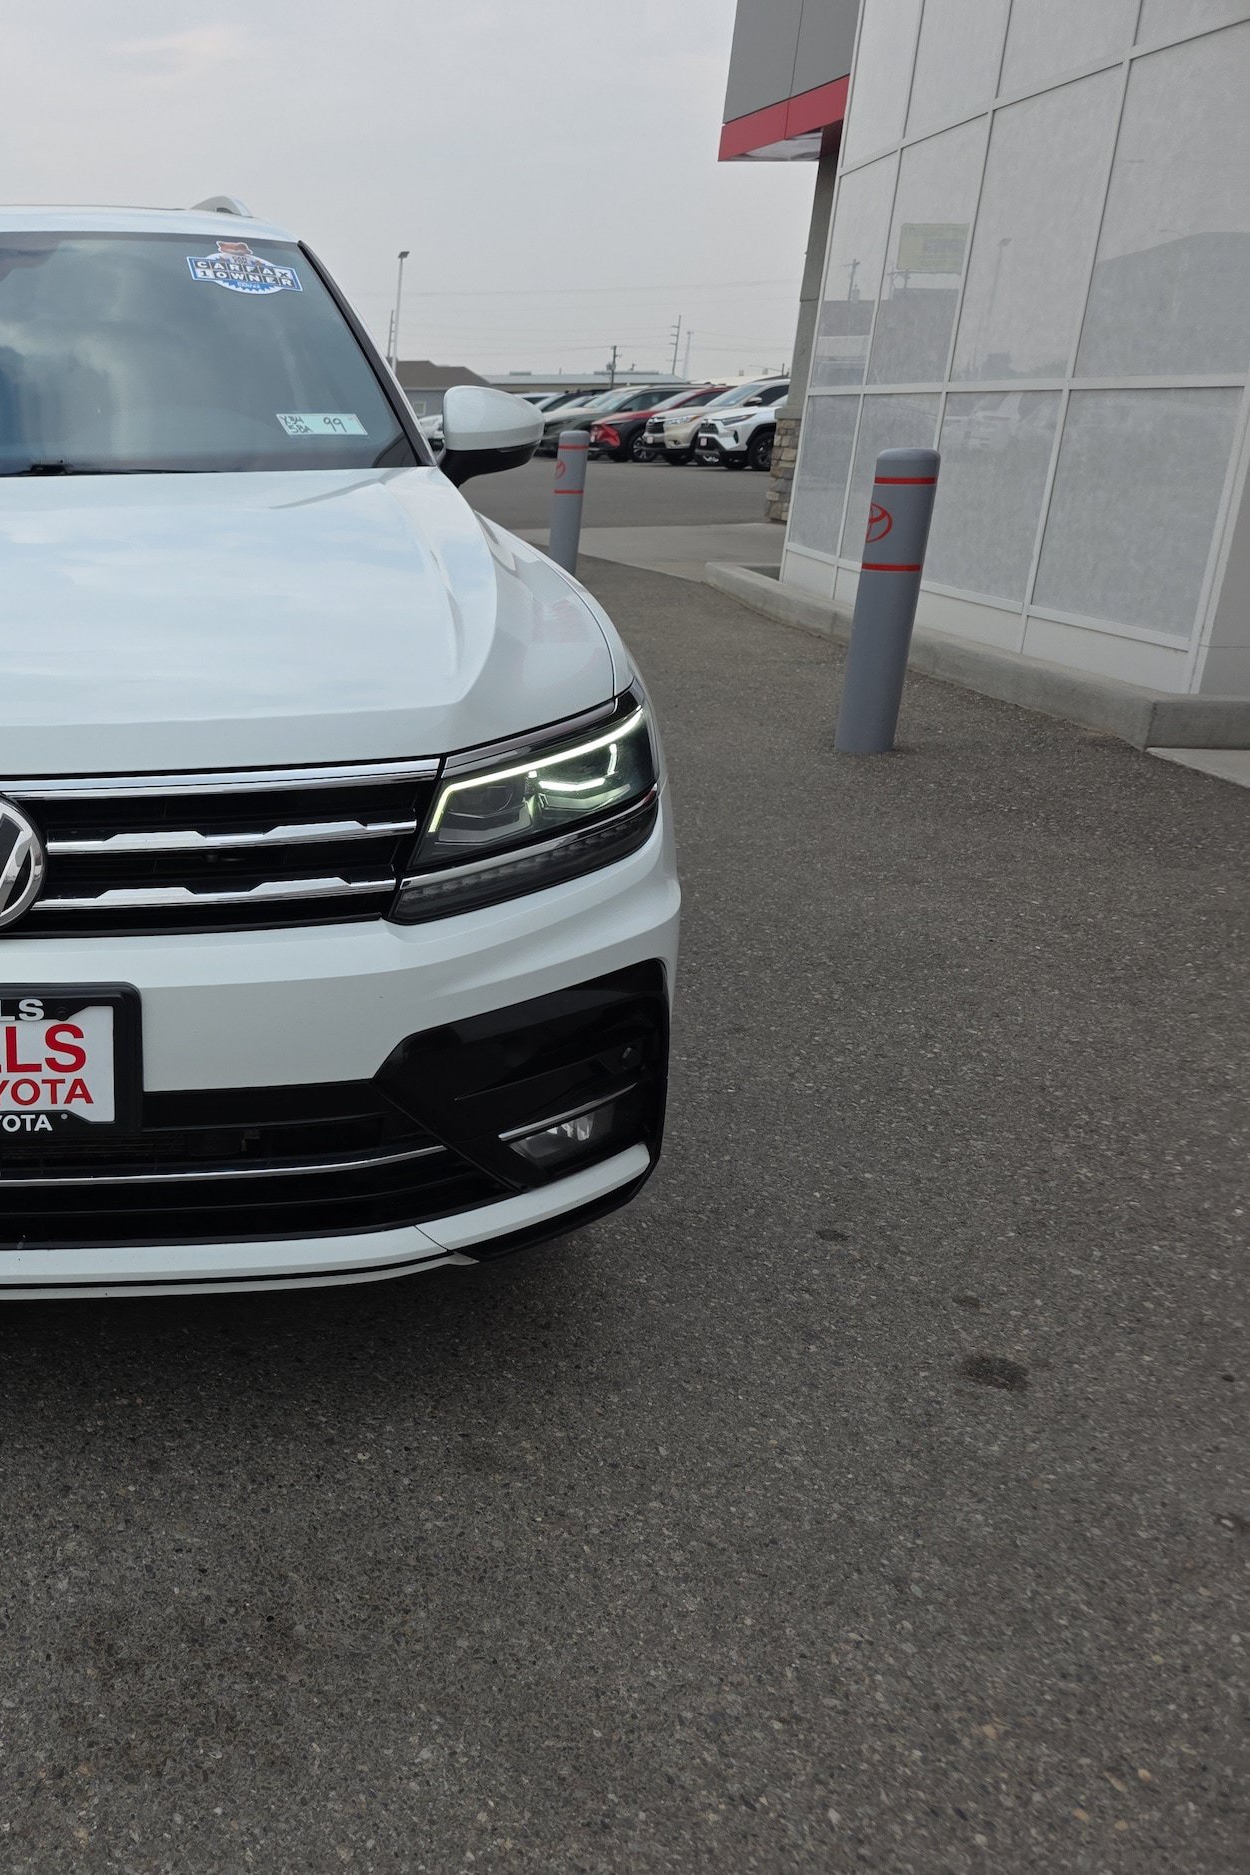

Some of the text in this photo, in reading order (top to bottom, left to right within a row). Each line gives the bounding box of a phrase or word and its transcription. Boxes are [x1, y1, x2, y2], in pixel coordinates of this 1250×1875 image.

[196, 261, 289, 278] CARFAX
[215, 272, 292, 287] OWNER
[323, 416, 347, 433] 99
